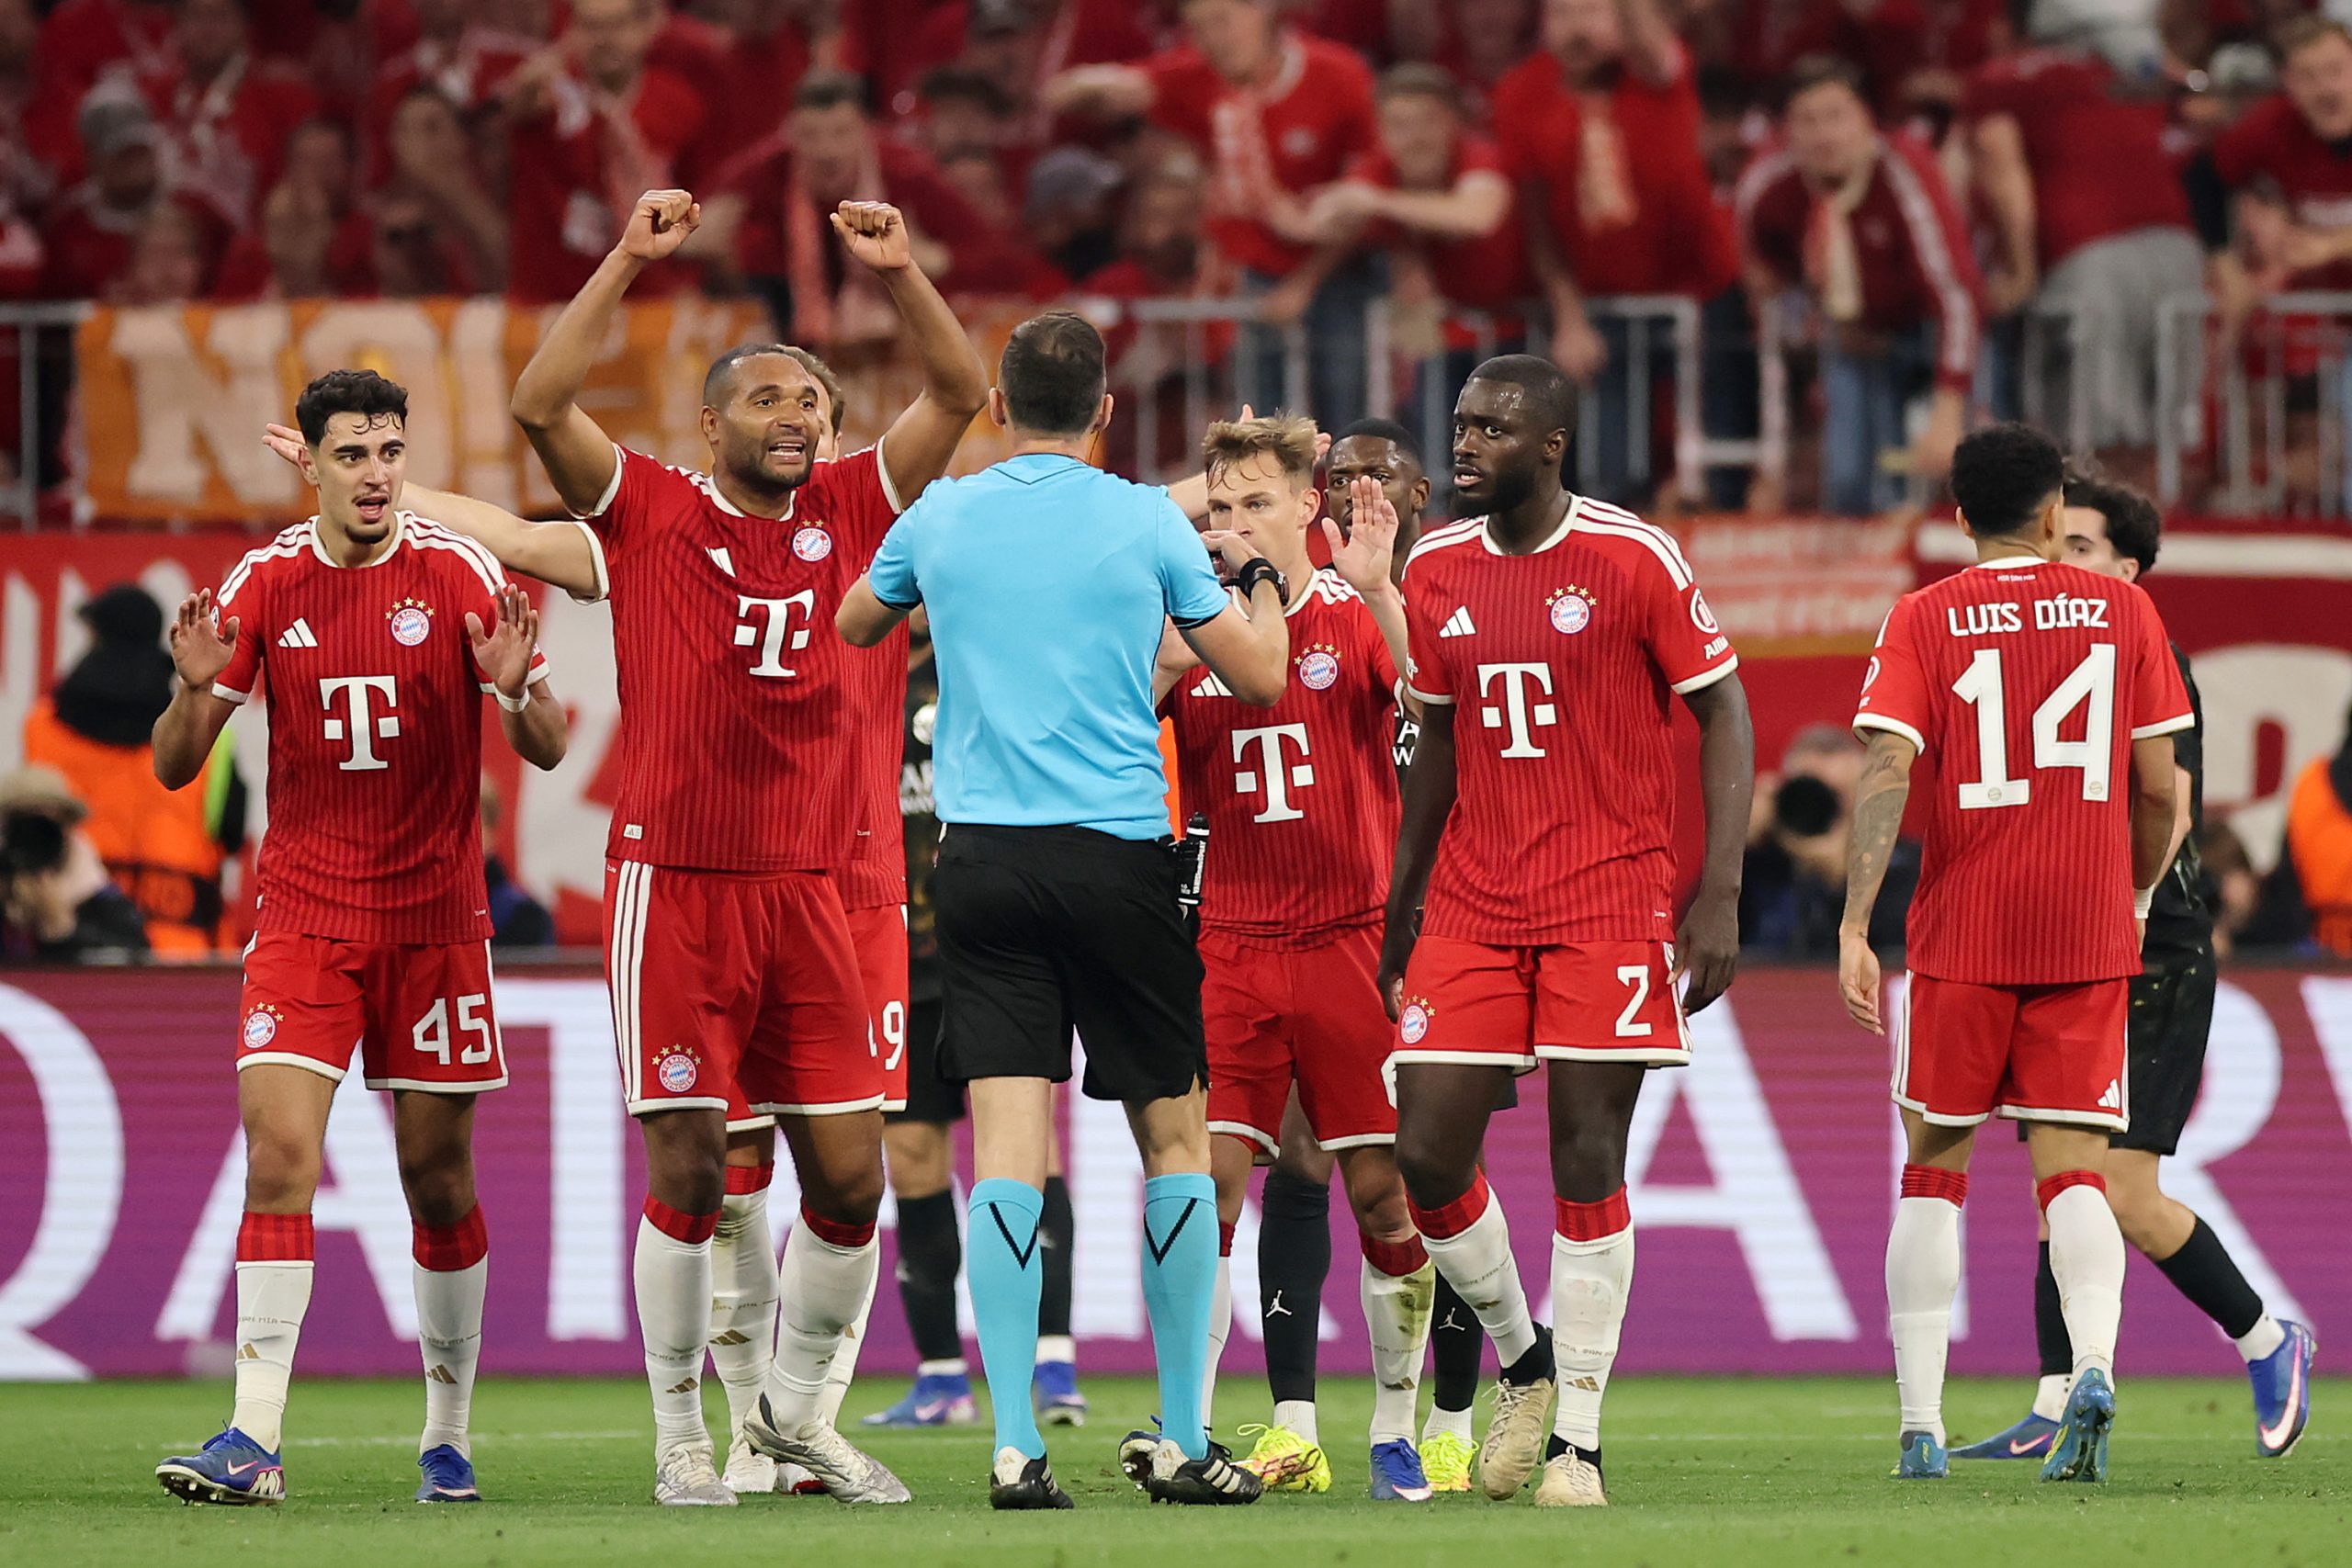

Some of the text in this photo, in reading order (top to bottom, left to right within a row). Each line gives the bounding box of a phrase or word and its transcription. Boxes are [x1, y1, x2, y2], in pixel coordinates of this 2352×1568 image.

[1948, 592, 2109, 637] LUIS DÍAZ
[1952, 643, 2116, 809] 14
[413, 994, 492, 1065] 45
[1615, 964, 1652, 1037] 2
